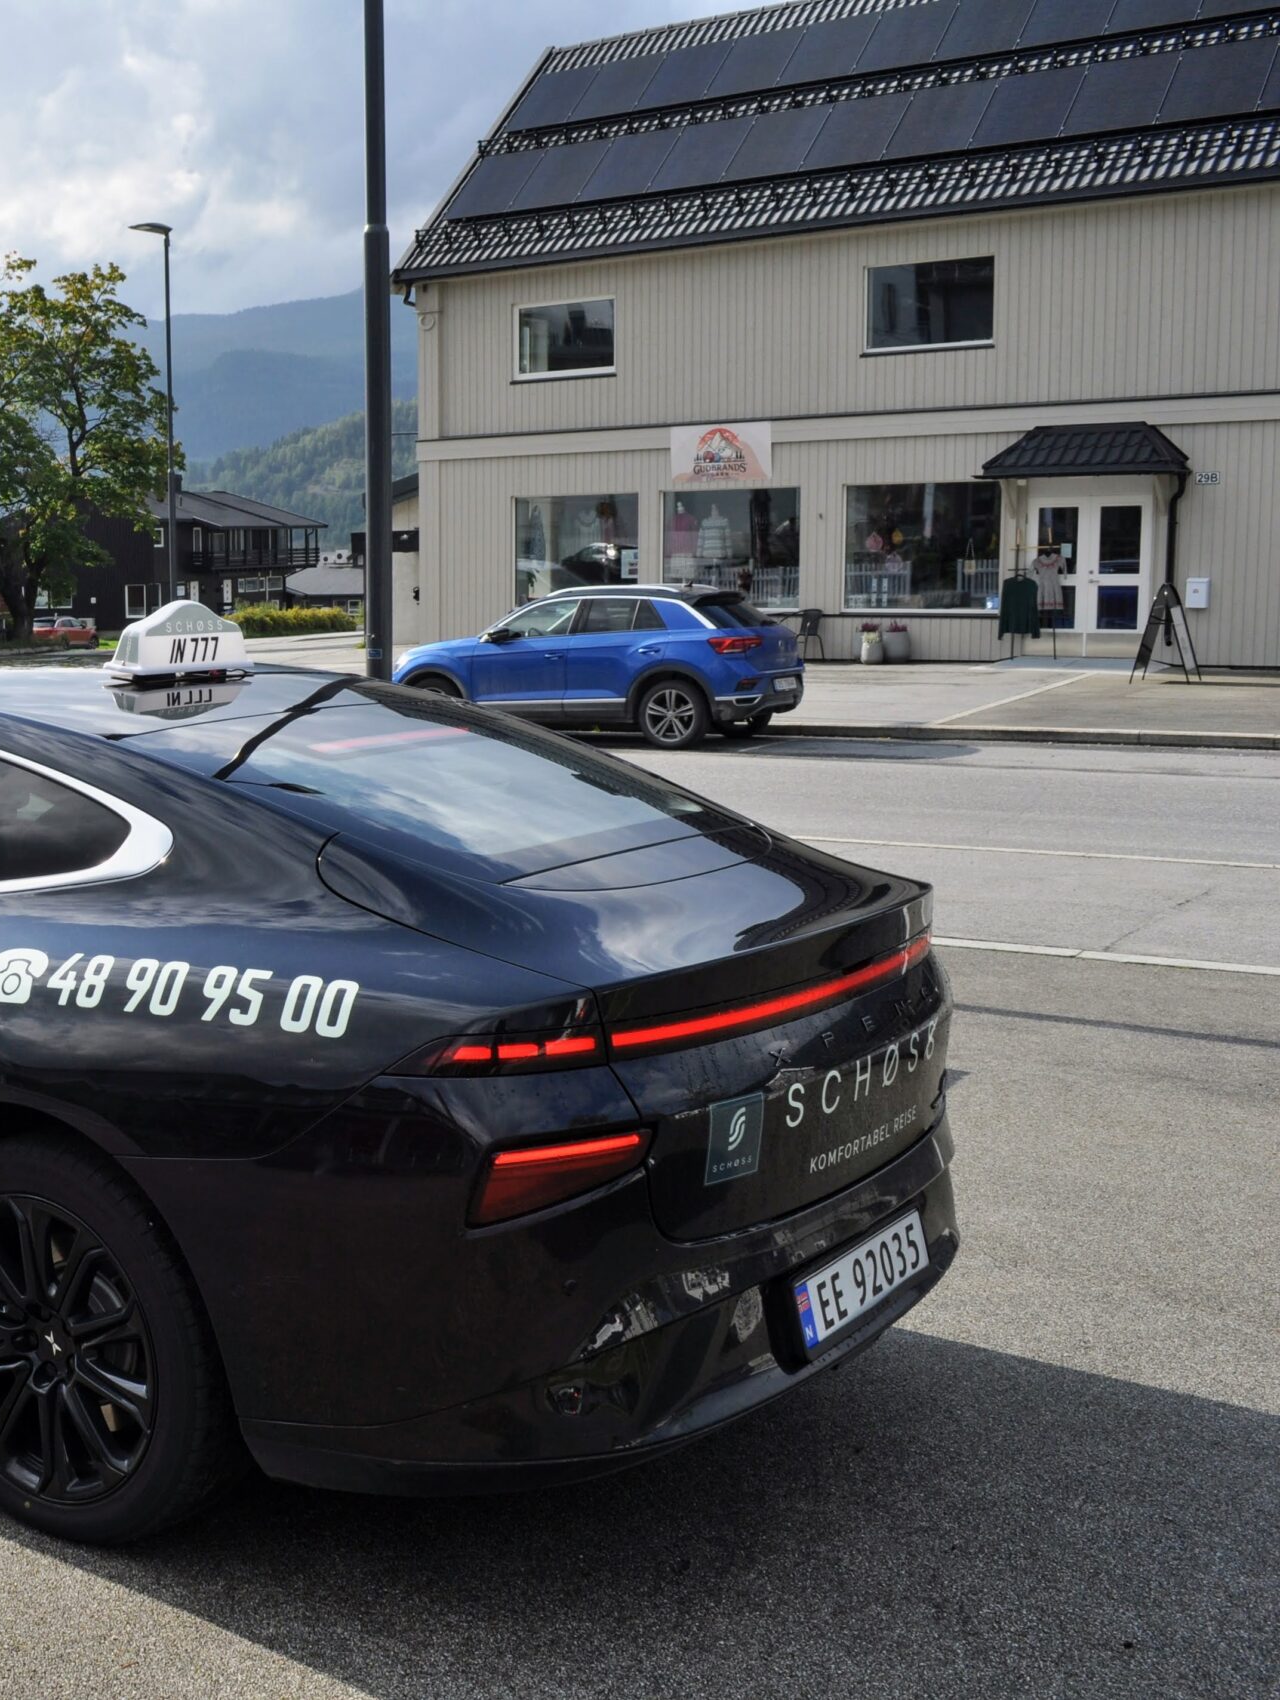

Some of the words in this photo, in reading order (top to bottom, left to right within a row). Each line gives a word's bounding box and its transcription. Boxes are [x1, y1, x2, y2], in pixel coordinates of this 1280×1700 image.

[1198, 473, 1218, 483] 29B
[166, 620, 223, 633] SCHØSS
[169, 638, 187, 664] IN
[190, 636, 219, 662] 777
[46, 952, 115, 1009] 48
[123, 958, 190, 1016] 90
[201, 965, 273, 1026] 95
[280, 974, 360, 1038] 00
[809, 1123, 890, 1174] KOMFORTABEL
[893, 1104, 917, 1136] REISE
[712, 1155, 753, 1173] SCHØSS
[816, 1271, 848, 1330] EE
[852, 1223, 920, 1306] 92035
